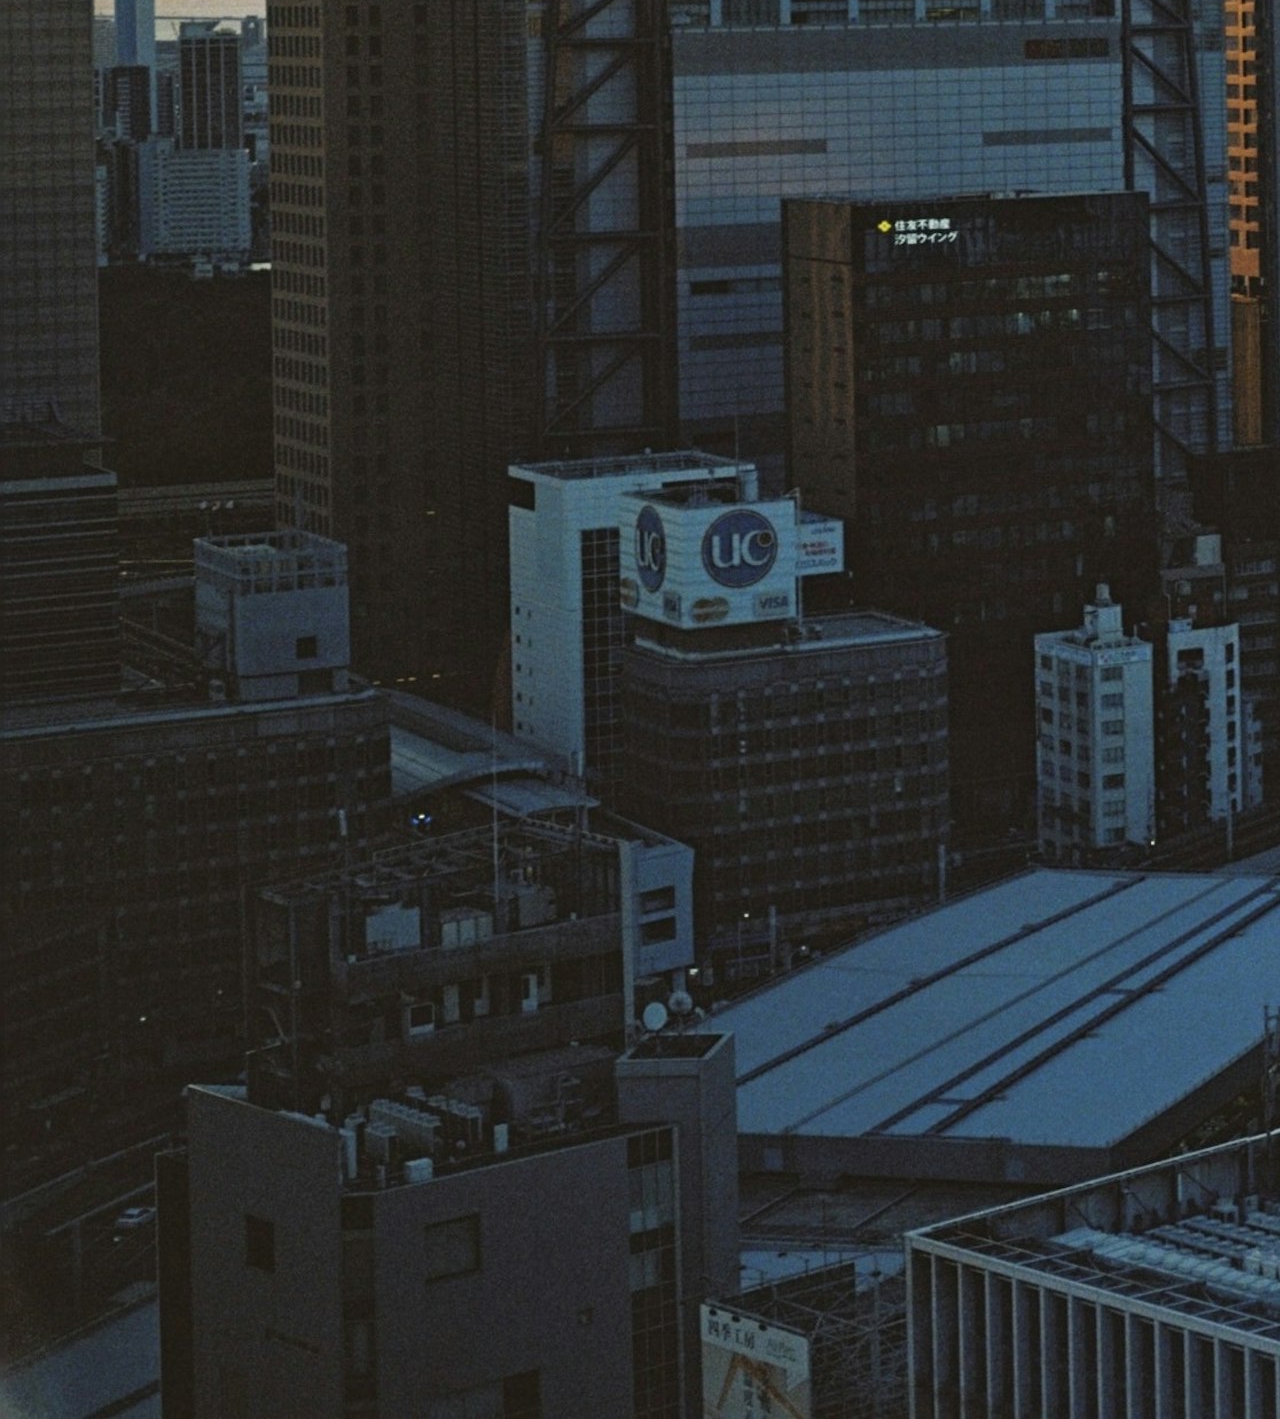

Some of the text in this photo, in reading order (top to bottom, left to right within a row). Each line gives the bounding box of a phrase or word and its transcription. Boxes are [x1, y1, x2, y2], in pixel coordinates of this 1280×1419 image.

[895, 219, 950, 231] 住友不動産
[760, 595, 789, 609] VISA
